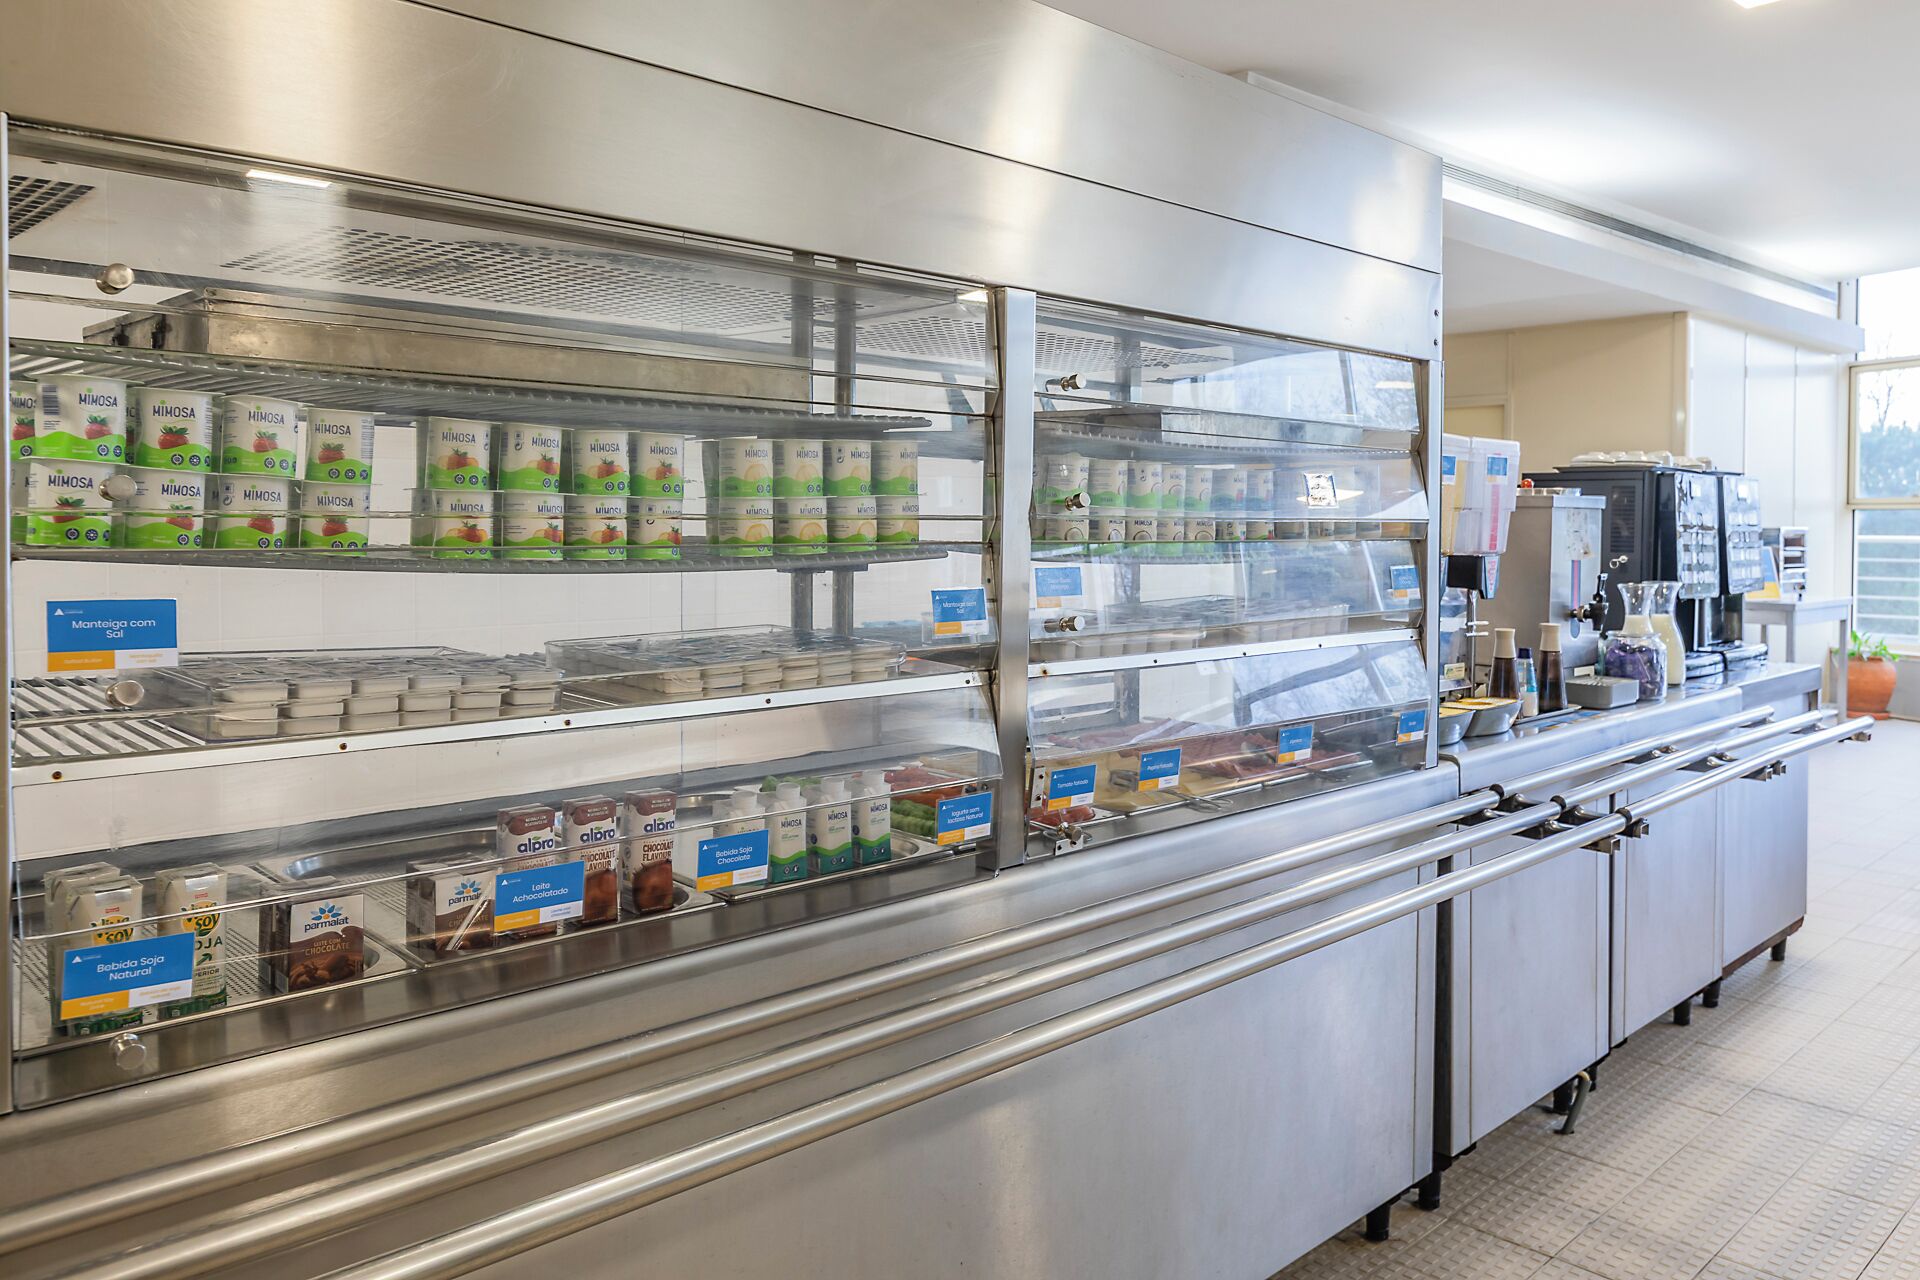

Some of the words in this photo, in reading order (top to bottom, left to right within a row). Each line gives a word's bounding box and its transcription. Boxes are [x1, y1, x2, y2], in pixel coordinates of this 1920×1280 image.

[78, 392, 118, 408] MIMOSA
[152, 404, 196, 419] MIMOSA
[248, 409, 285, 425] MIMOSA
[314, 422, 352, 436] MIMOSA
[441, 430, 476, 443] MIMOSA
[531, 436, 560, 448] MIMOSA
[589, 442, 621, 453] MIMOSA
[649, 444, 678, 456] MIMOSA
[745, 448, 768, 458] MIMOSA
[48, 474, 94, 489] MIMOSA
[161, 483, 201, 497] MIMOSA
[243, 488, 282, 503] MIMOSA
[317, 495, 354, 508] MIMOSA
[72, 619, 128, 631] Manteiga
[130, 619, 156, 628] com
[105, 629, 124, 638] Sal
[870, 803, 888, 813] MIMOSA
[827, 811, 848, 821] MIMOSA
[643, 818, 675, 833] alpro
[780, 818, 802, 829] MIMOSA
[579, 827, 616, 843] alpro
[516, 837, 555, 853] alpro
[715, 848, 739, 858] Bebida
[739, 845, 753, 855] Soja
[642, 850, 672, 862] FLAVOUR
[717, 853, 751, 865] Chocolate
[531, 881, 551, 892] Leite
[448, 892, 483, 907] parmal
[512, 887, 569, 904] Achocolatado
[304, 916, 350, 933] parmalat
[194, 935, 223, 951] OJA
[305, 941, 351, 956] CHOCOLATE
[96, 959, 138, 973] Bebida
[140, 954, 165, 967] Soja
[109, 966, 152, 981] Natural
